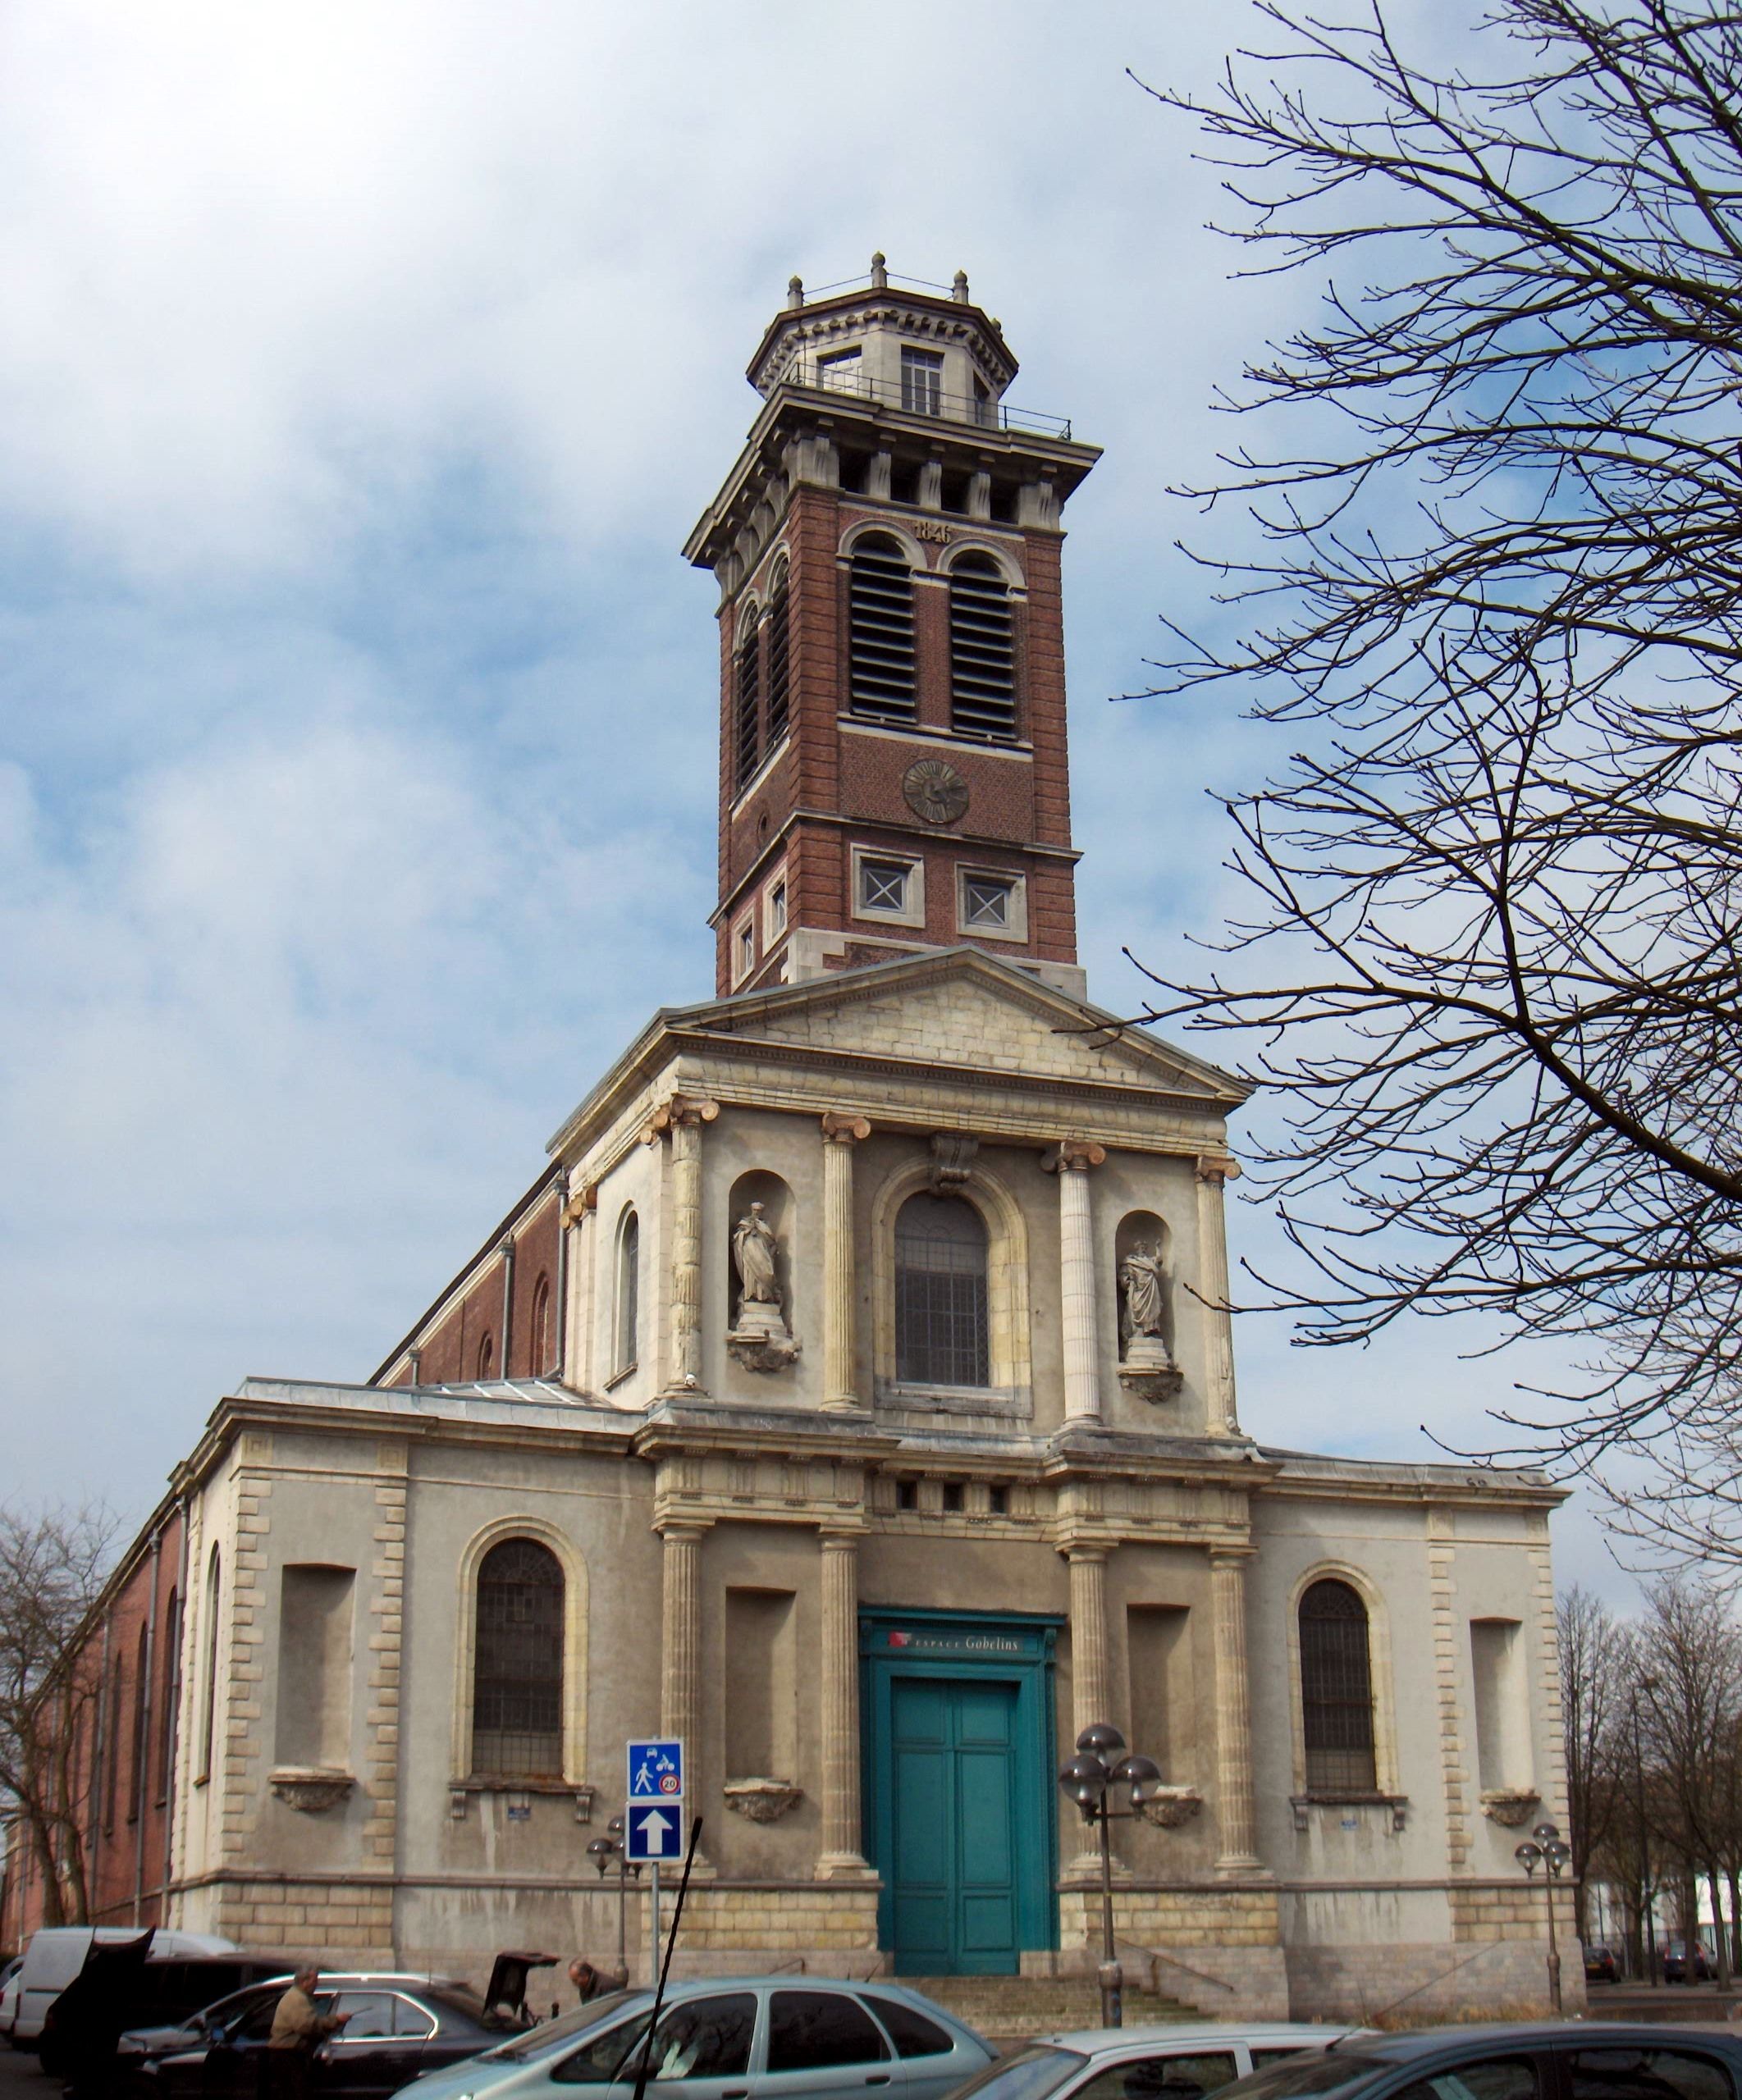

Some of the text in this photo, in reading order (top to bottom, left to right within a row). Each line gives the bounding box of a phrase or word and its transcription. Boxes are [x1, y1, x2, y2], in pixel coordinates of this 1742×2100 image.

[915, 522, 951, 543] 1846
[916, 1636, 1018, 1650] ESPACE Gobelins
